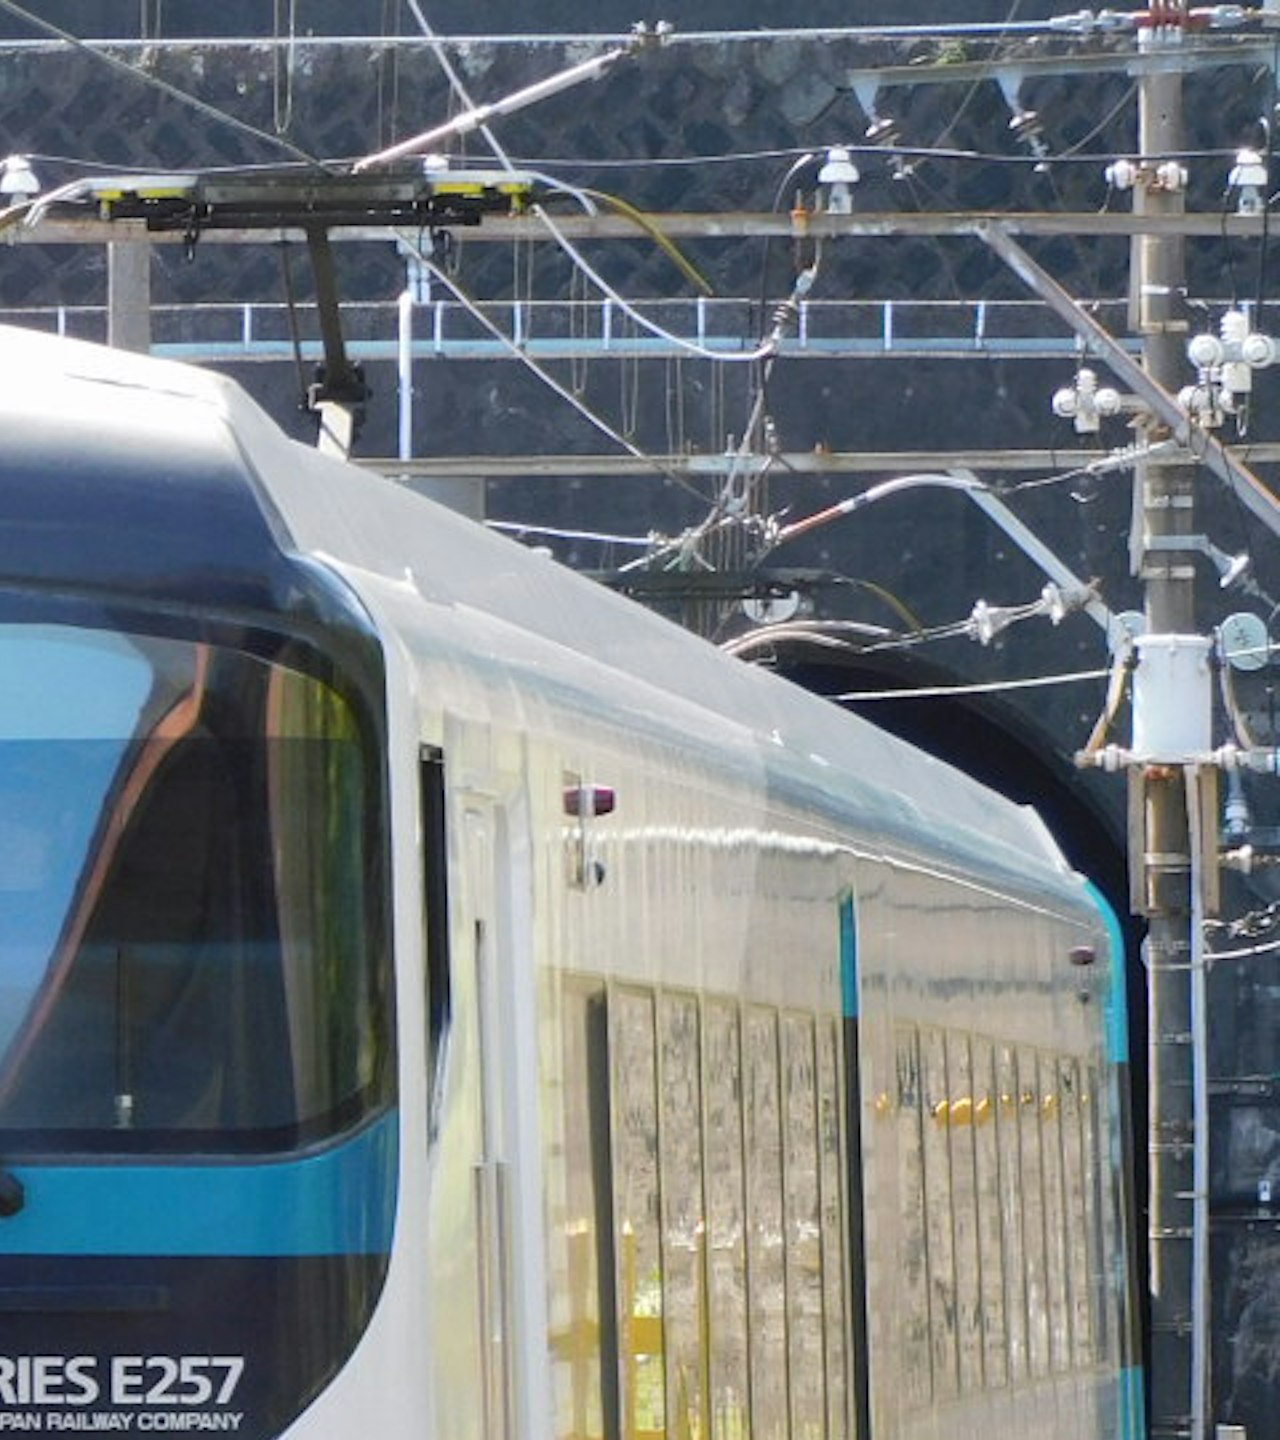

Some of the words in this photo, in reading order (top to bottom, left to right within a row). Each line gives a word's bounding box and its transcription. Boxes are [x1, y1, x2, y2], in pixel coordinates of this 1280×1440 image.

[111, 1356, 246, 1406] E257
[46, 1412, 135, 1431] RAILWAY
[137, 1412, 245, 1431] COMPANY
